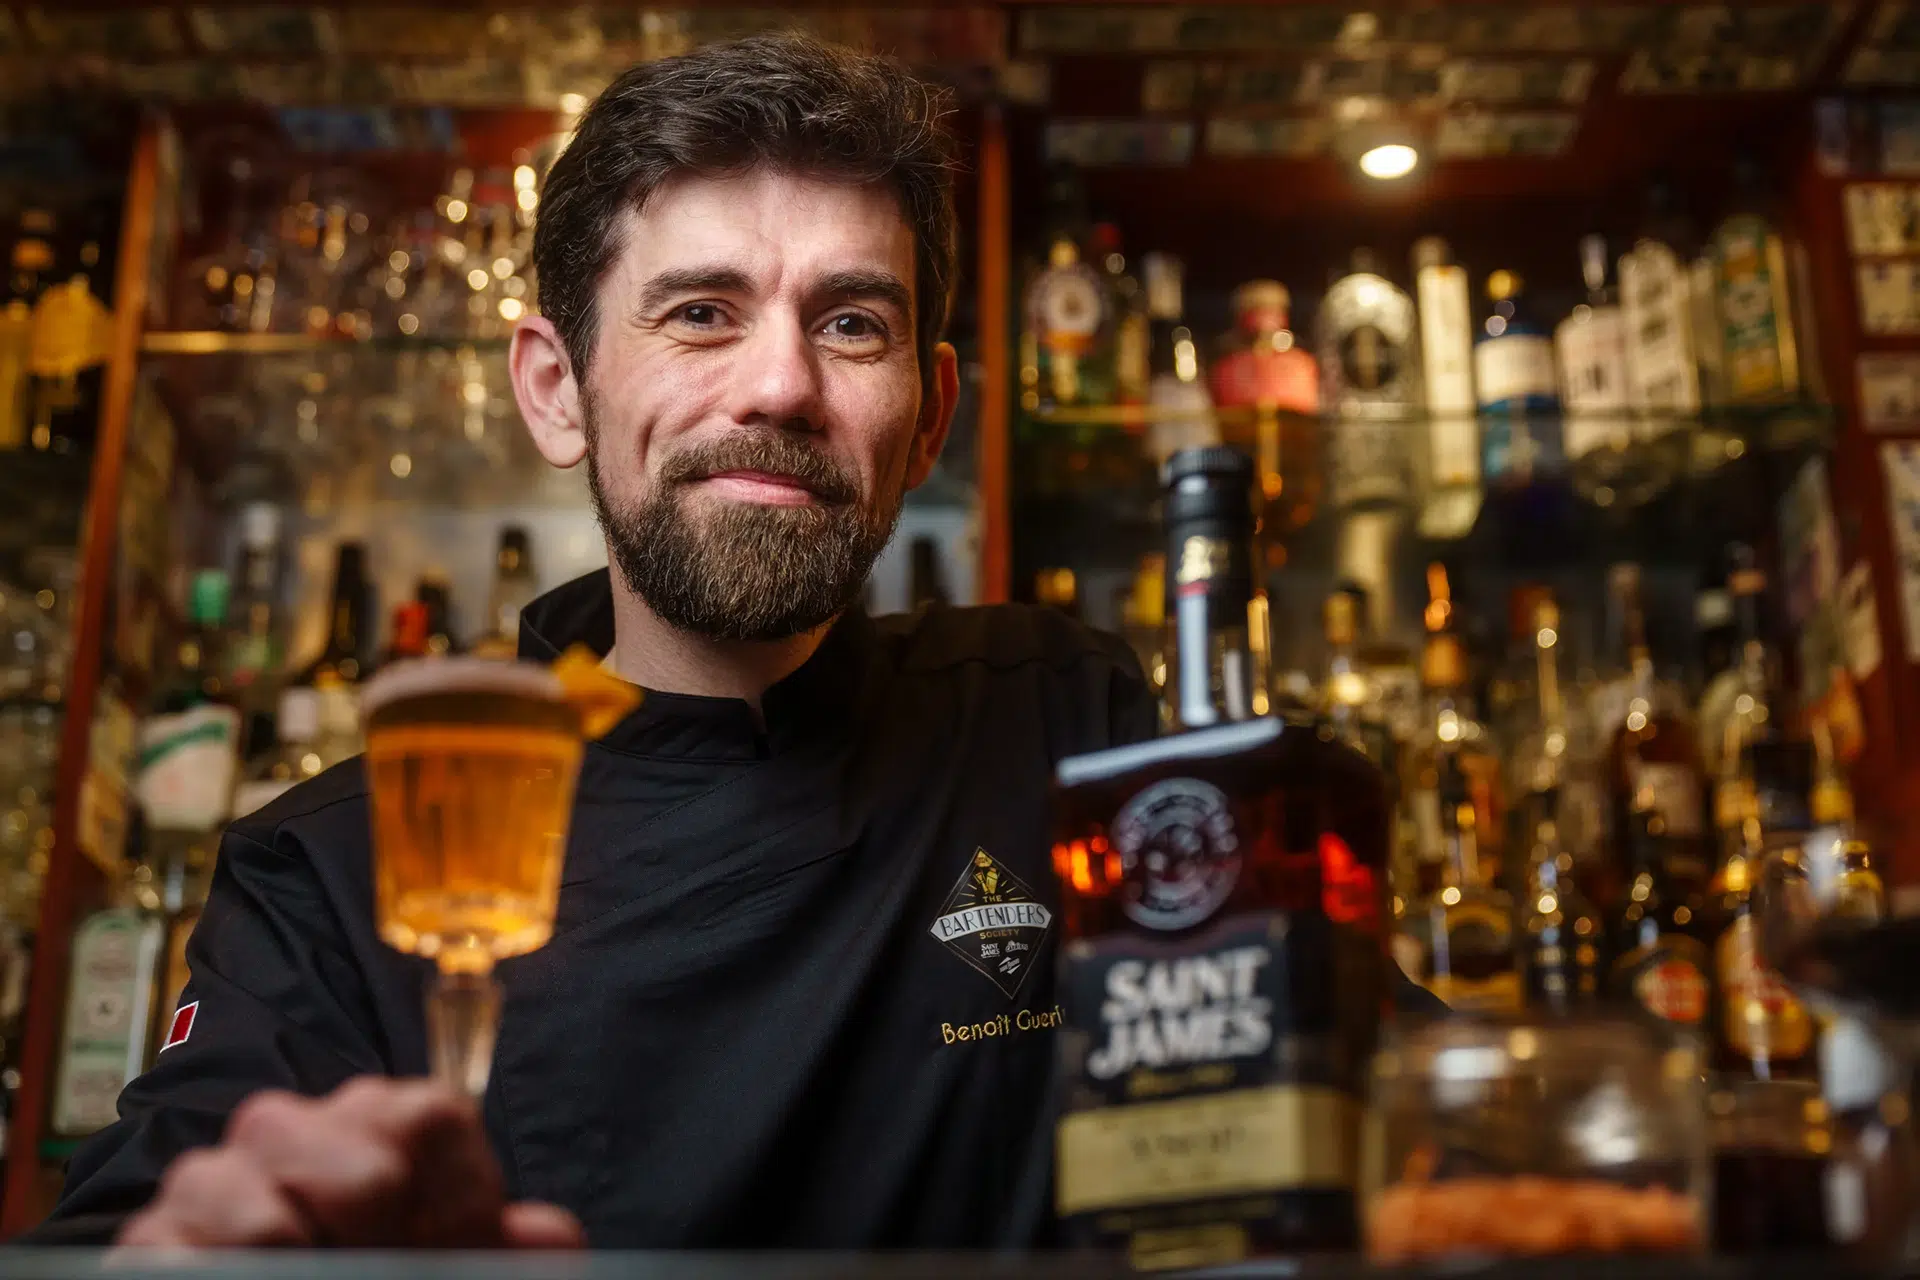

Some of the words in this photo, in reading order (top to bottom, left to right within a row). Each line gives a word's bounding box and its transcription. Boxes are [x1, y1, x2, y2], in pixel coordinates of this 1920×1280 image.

[983, 895, 1002, 903] THE
[940, 905, 1045, 937] BARTENDERS
[980, 929, 1020, 940] SOCIETY
[981, 943, 999, 951] SAINT
[1103, 946, 1271, 1022] SAINT
[942, 1014, 1011, 1044] Benoît
[1016, 1005, 1066, 1031] Gueri
[1088, 998, 1272, 1079] JAMES
